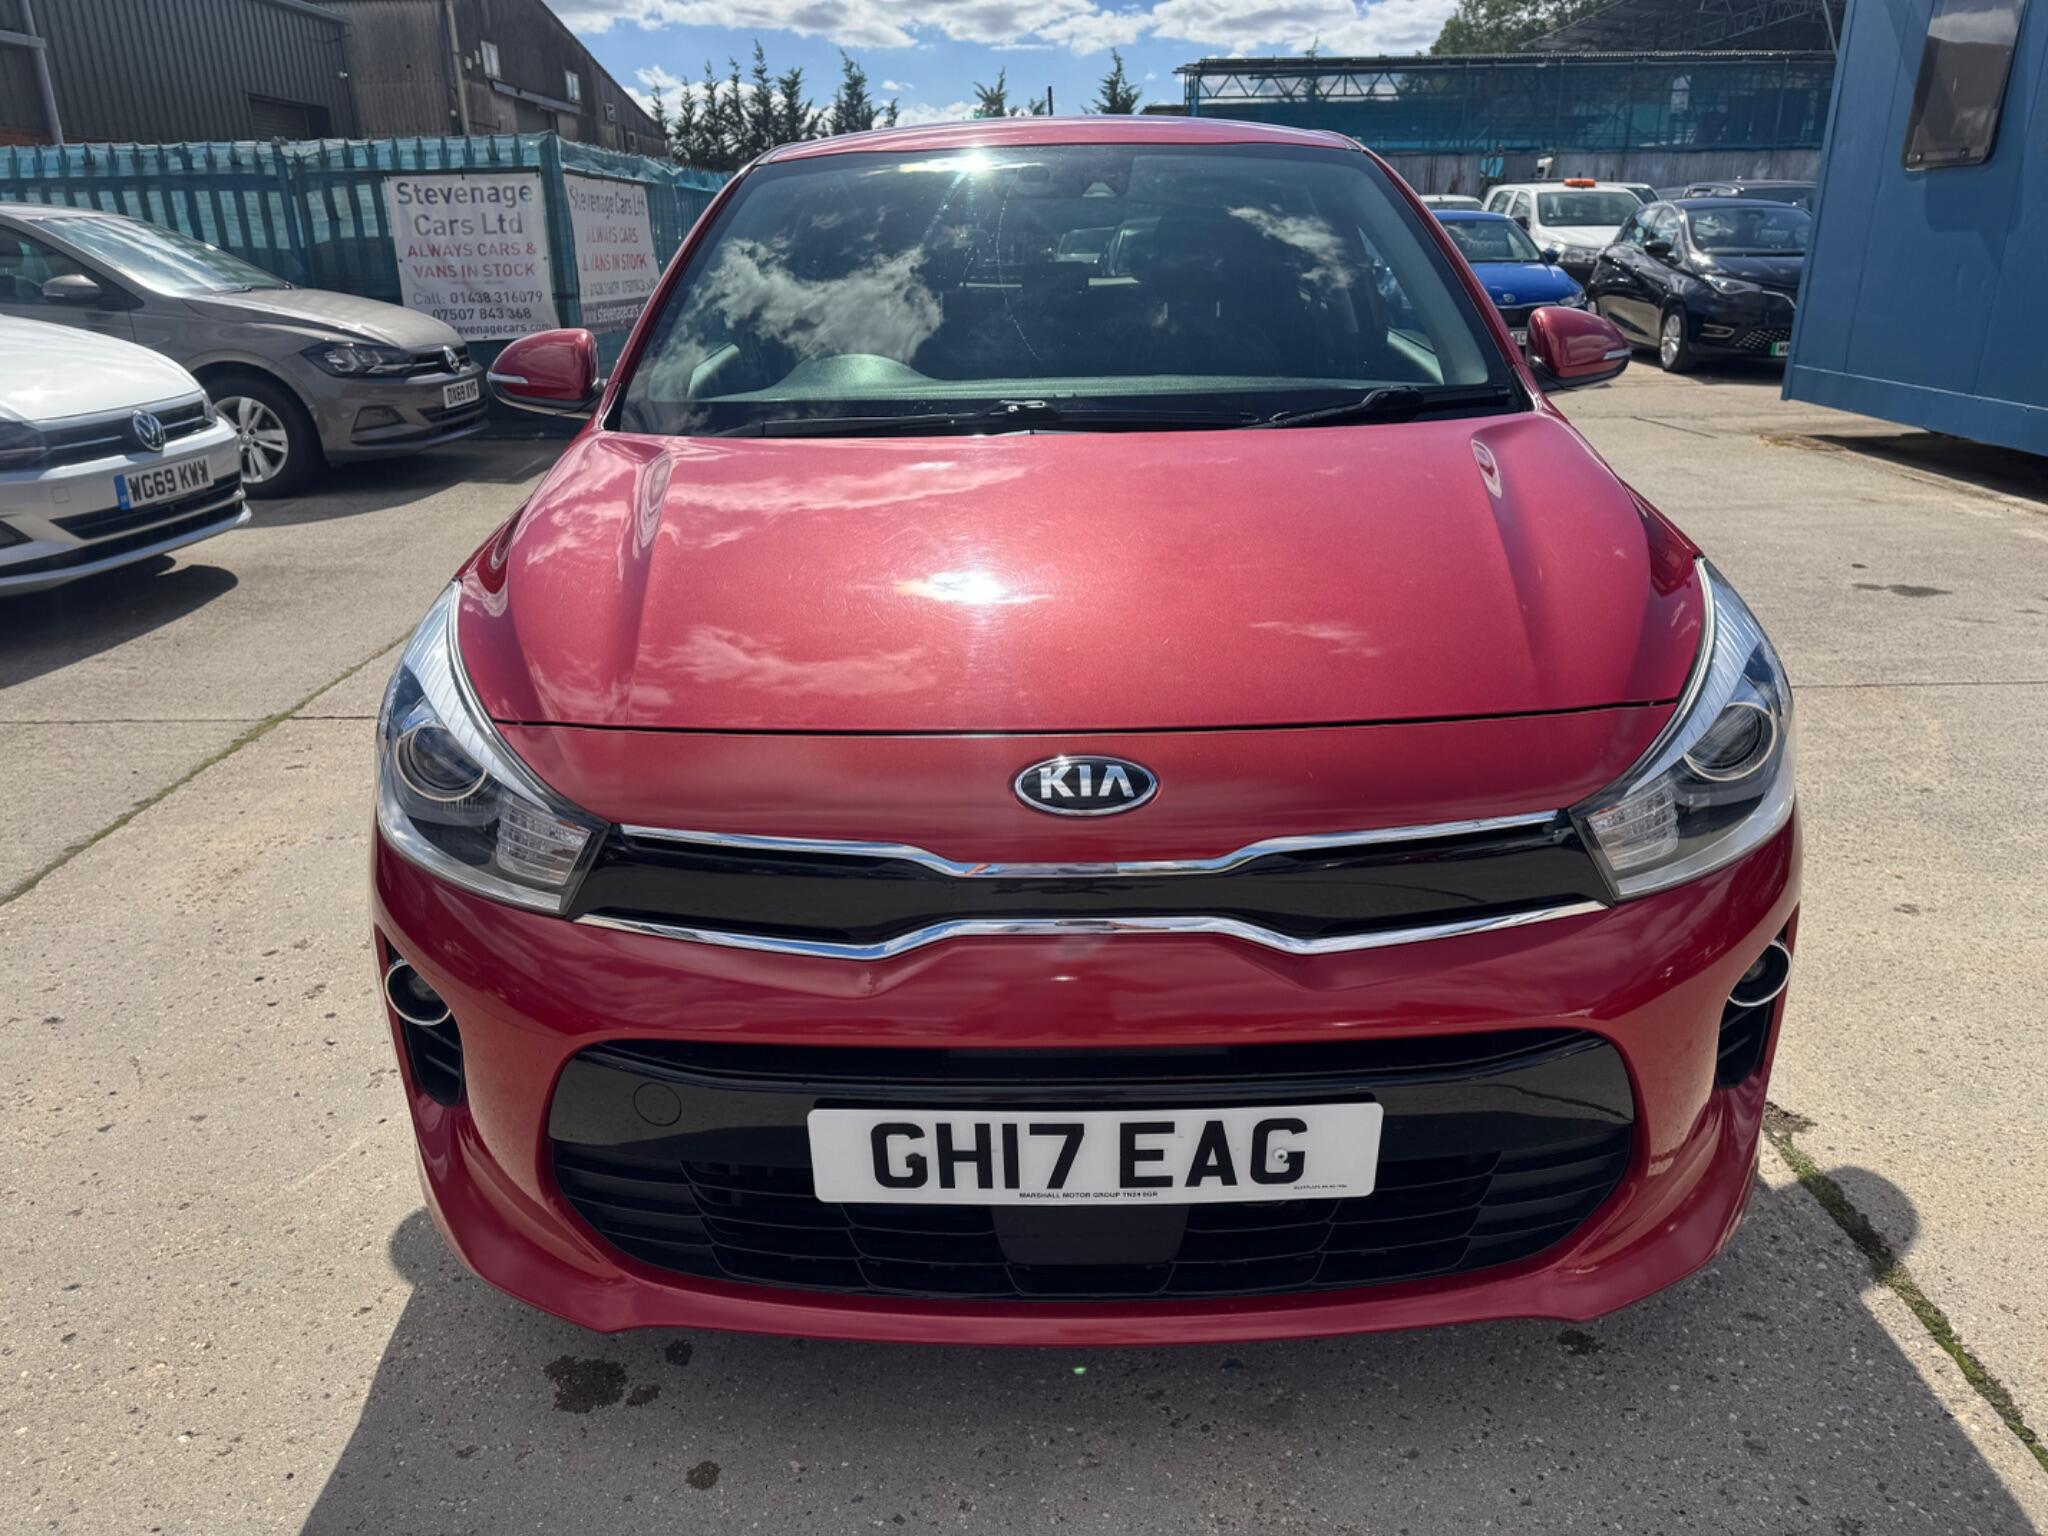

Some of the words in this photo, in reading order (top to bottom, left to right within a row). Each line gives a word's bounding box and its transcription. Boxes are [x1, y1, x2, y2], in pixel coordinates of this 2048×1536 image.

[396, 181, 533, 209] Stevenage
[614, 191, 632, 216] Cars
[414, 213, 474, 237] Cars
[481, 211, 524, 235] Ltd
[407, 243, 473, 258] ALWAYS
[477, 243, 521, 257] CARS
[526, 242, 536, 255] &
[413, 264, 457, 279] VANS
[461, 263, 478, 278] IN
[482, 263, 536, 277] STOCK
[413, 292, 446, 305] Call:
[450, 291, 491, 304] 01438
[494, 290, 543, 303] 316079
[432, 308, 475, 321] 07507
[479, 307, 504, 320] 843
[506, 307, 532, 319] 368
[128, 467, 177, 502] WG69
[178, 459, 209, 490] KWW
[1038, 764, 1136, 799] KIA
[870, 1122, 1086, 1190] GH17
[1119, 1117, 1308, 1189] EAG
